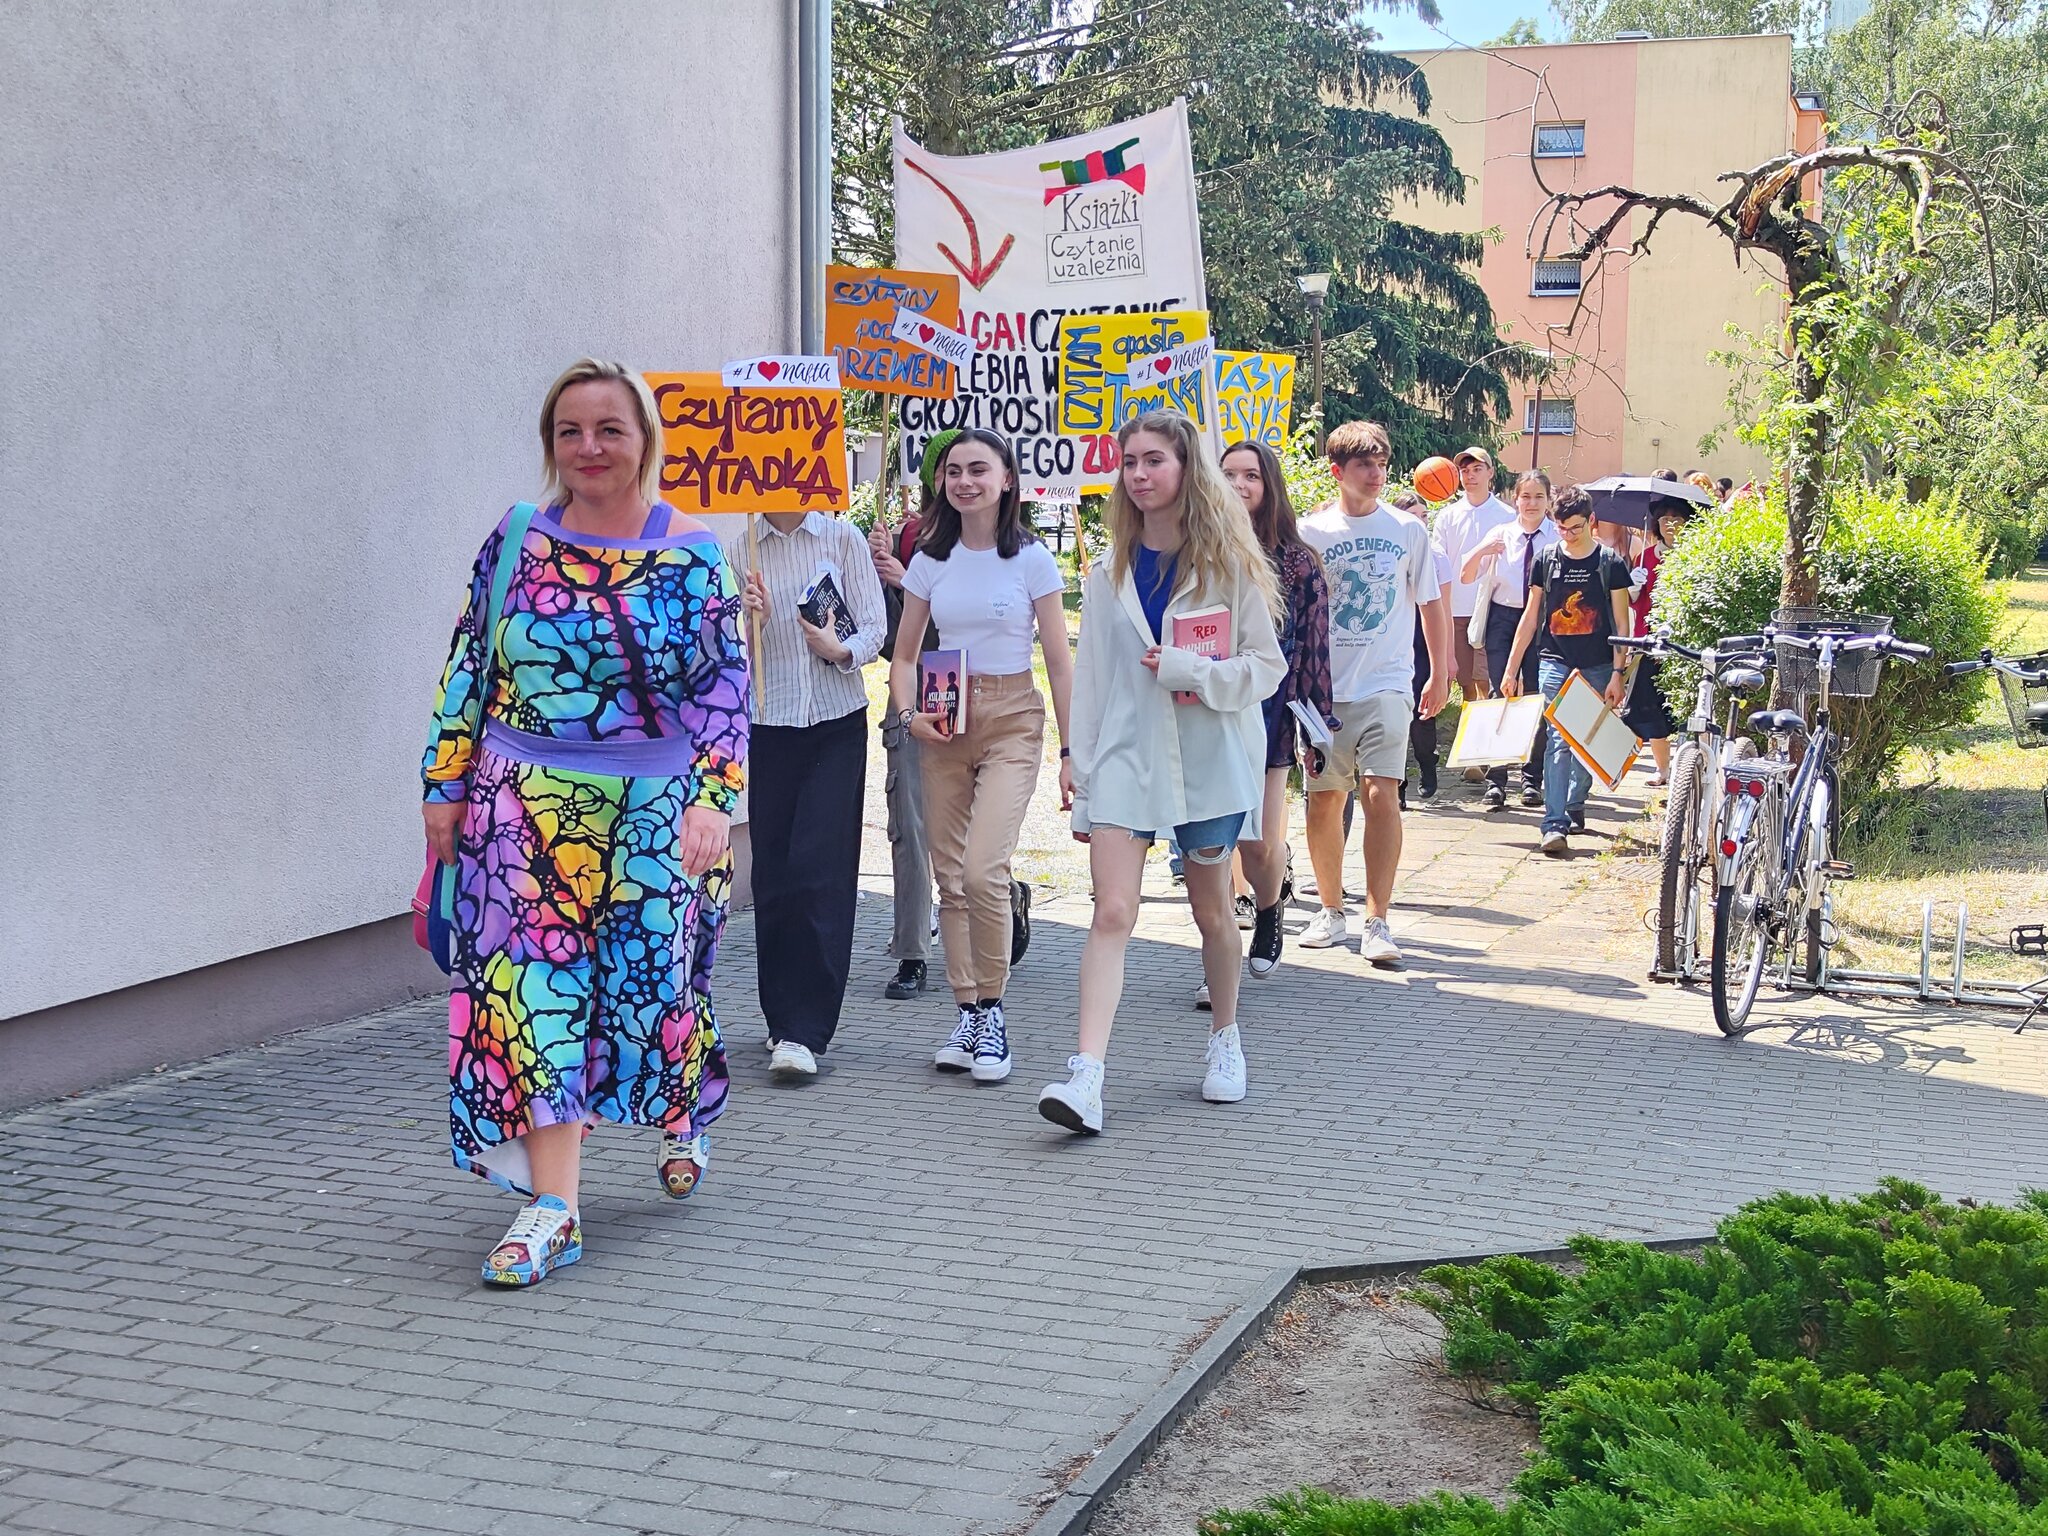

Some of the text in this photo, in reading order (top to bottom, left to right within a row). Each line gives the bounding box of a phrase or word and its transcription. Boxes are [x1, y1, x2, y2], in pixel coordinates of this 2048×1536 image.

[1061, 190, 1139, 231] Książki
[1051, 235, 1135, 260] Czytanie
[1054, 252, 1141, 277] uzależnia
[1064, 326, 1103, 429] CZYTAM
[653, 383, 838, 453] Czytamy
[1355, 538, 1407, 560] ENERGY
[1193, 625, 1217, 639] RED
[1182, 640, 1217, 653] WHITE
